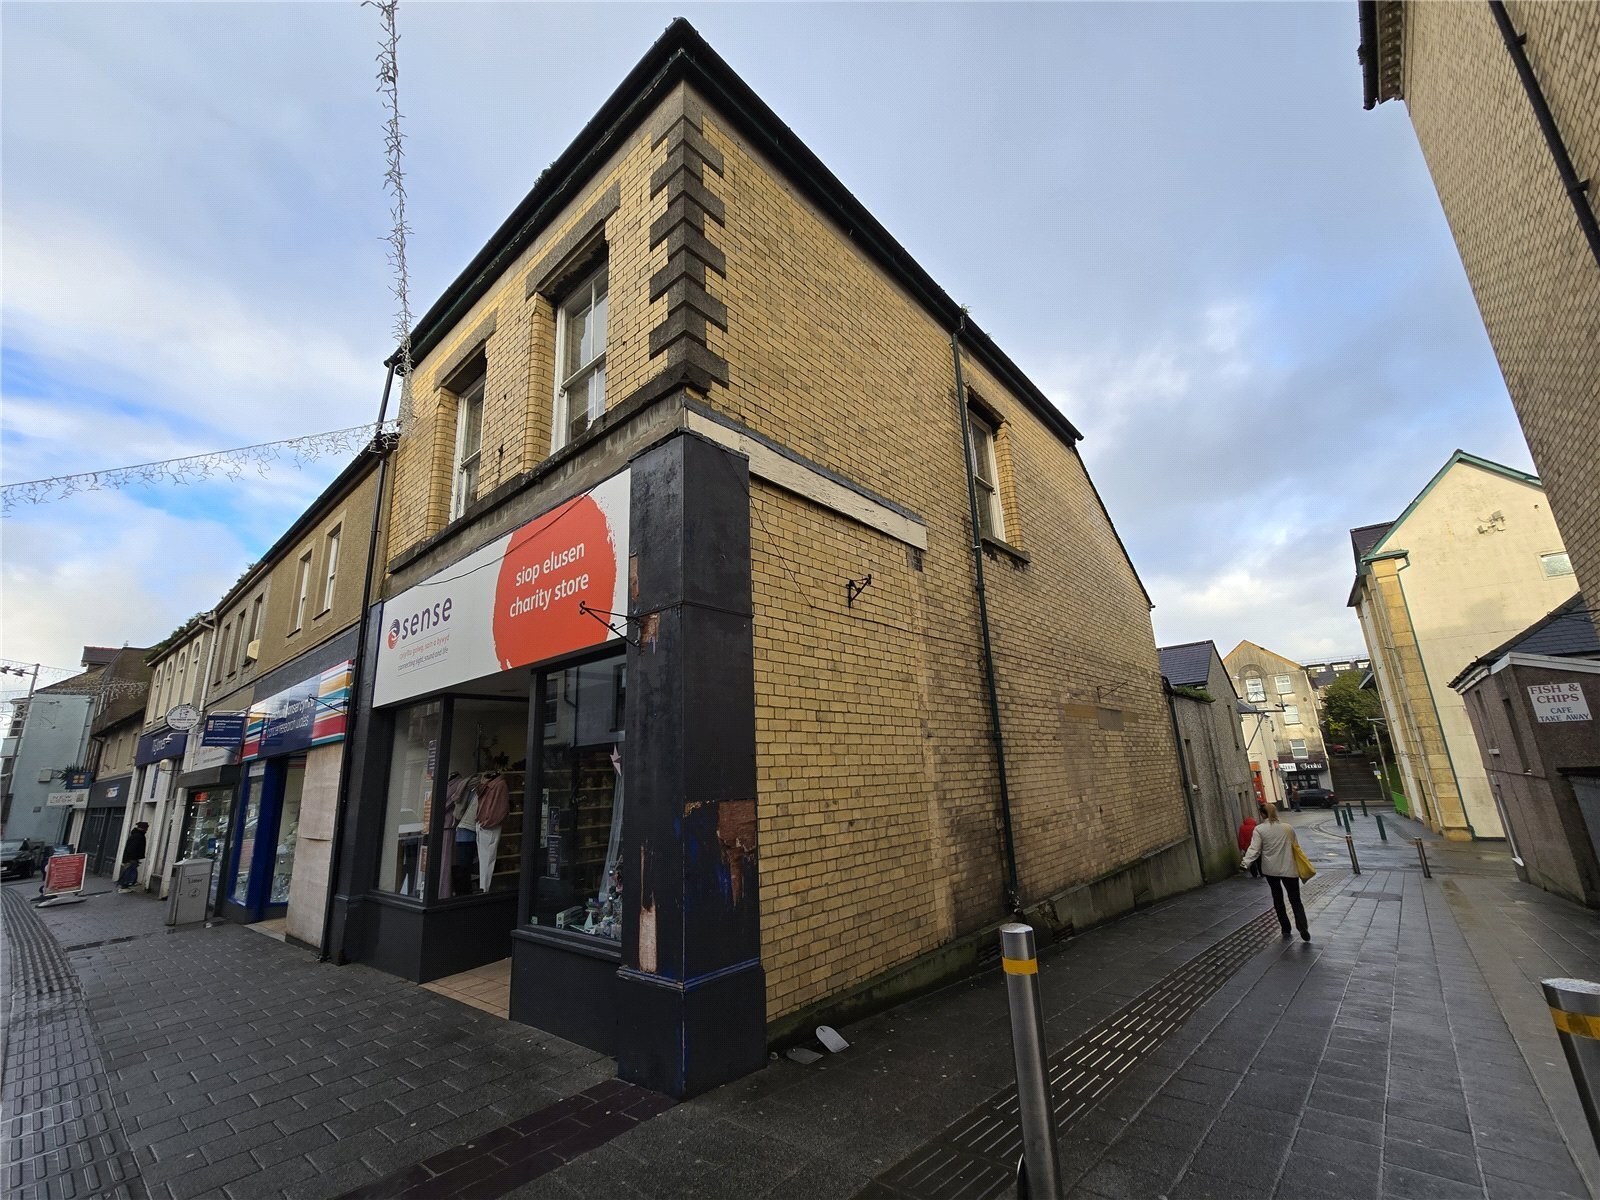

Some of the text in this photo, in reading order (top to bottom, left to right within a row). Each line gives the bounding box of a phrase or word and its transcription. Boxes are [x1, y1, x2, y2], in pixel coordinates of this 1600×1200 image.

[515, 543, 585, 587] siop elusen
[509, 573, 589, 618] charity store
[401, 597, 453, 640] sense
[1530, 683, 1580, 695] FISH &
[1536, 693, 1580, 704] CHIPS
[1566, 713, 1590, 721] AWAY
